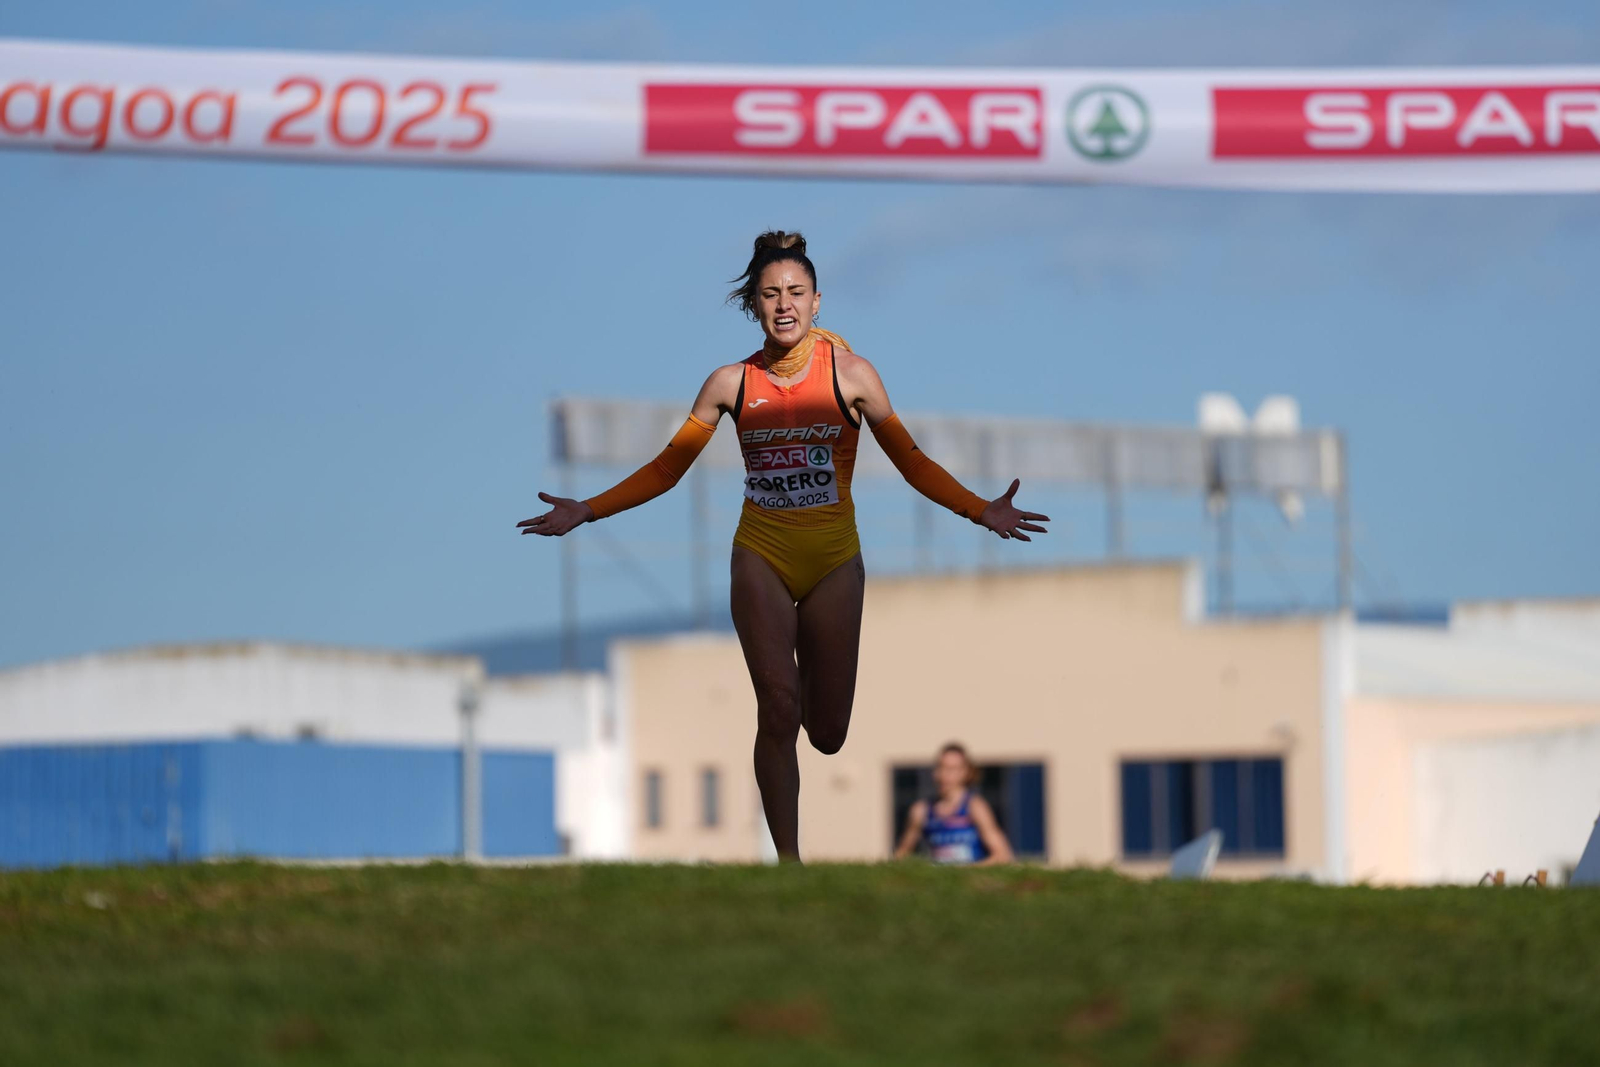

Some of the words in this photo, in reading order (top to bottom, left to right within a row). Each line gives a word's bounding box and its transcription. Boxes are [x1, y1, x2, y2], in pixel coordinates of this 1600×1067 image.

[263, 75, 498, 153] 2025
[733, 88, 1042, 149] SPAR
[1303, 90, 1600, 149] SPAR
[742, 424, 843, 444] ESPAÑA
[749, 450, 805, 468] SPAR
[748, 471, 832, 493] FORERO
[798, 491, 829, 506] 2025
